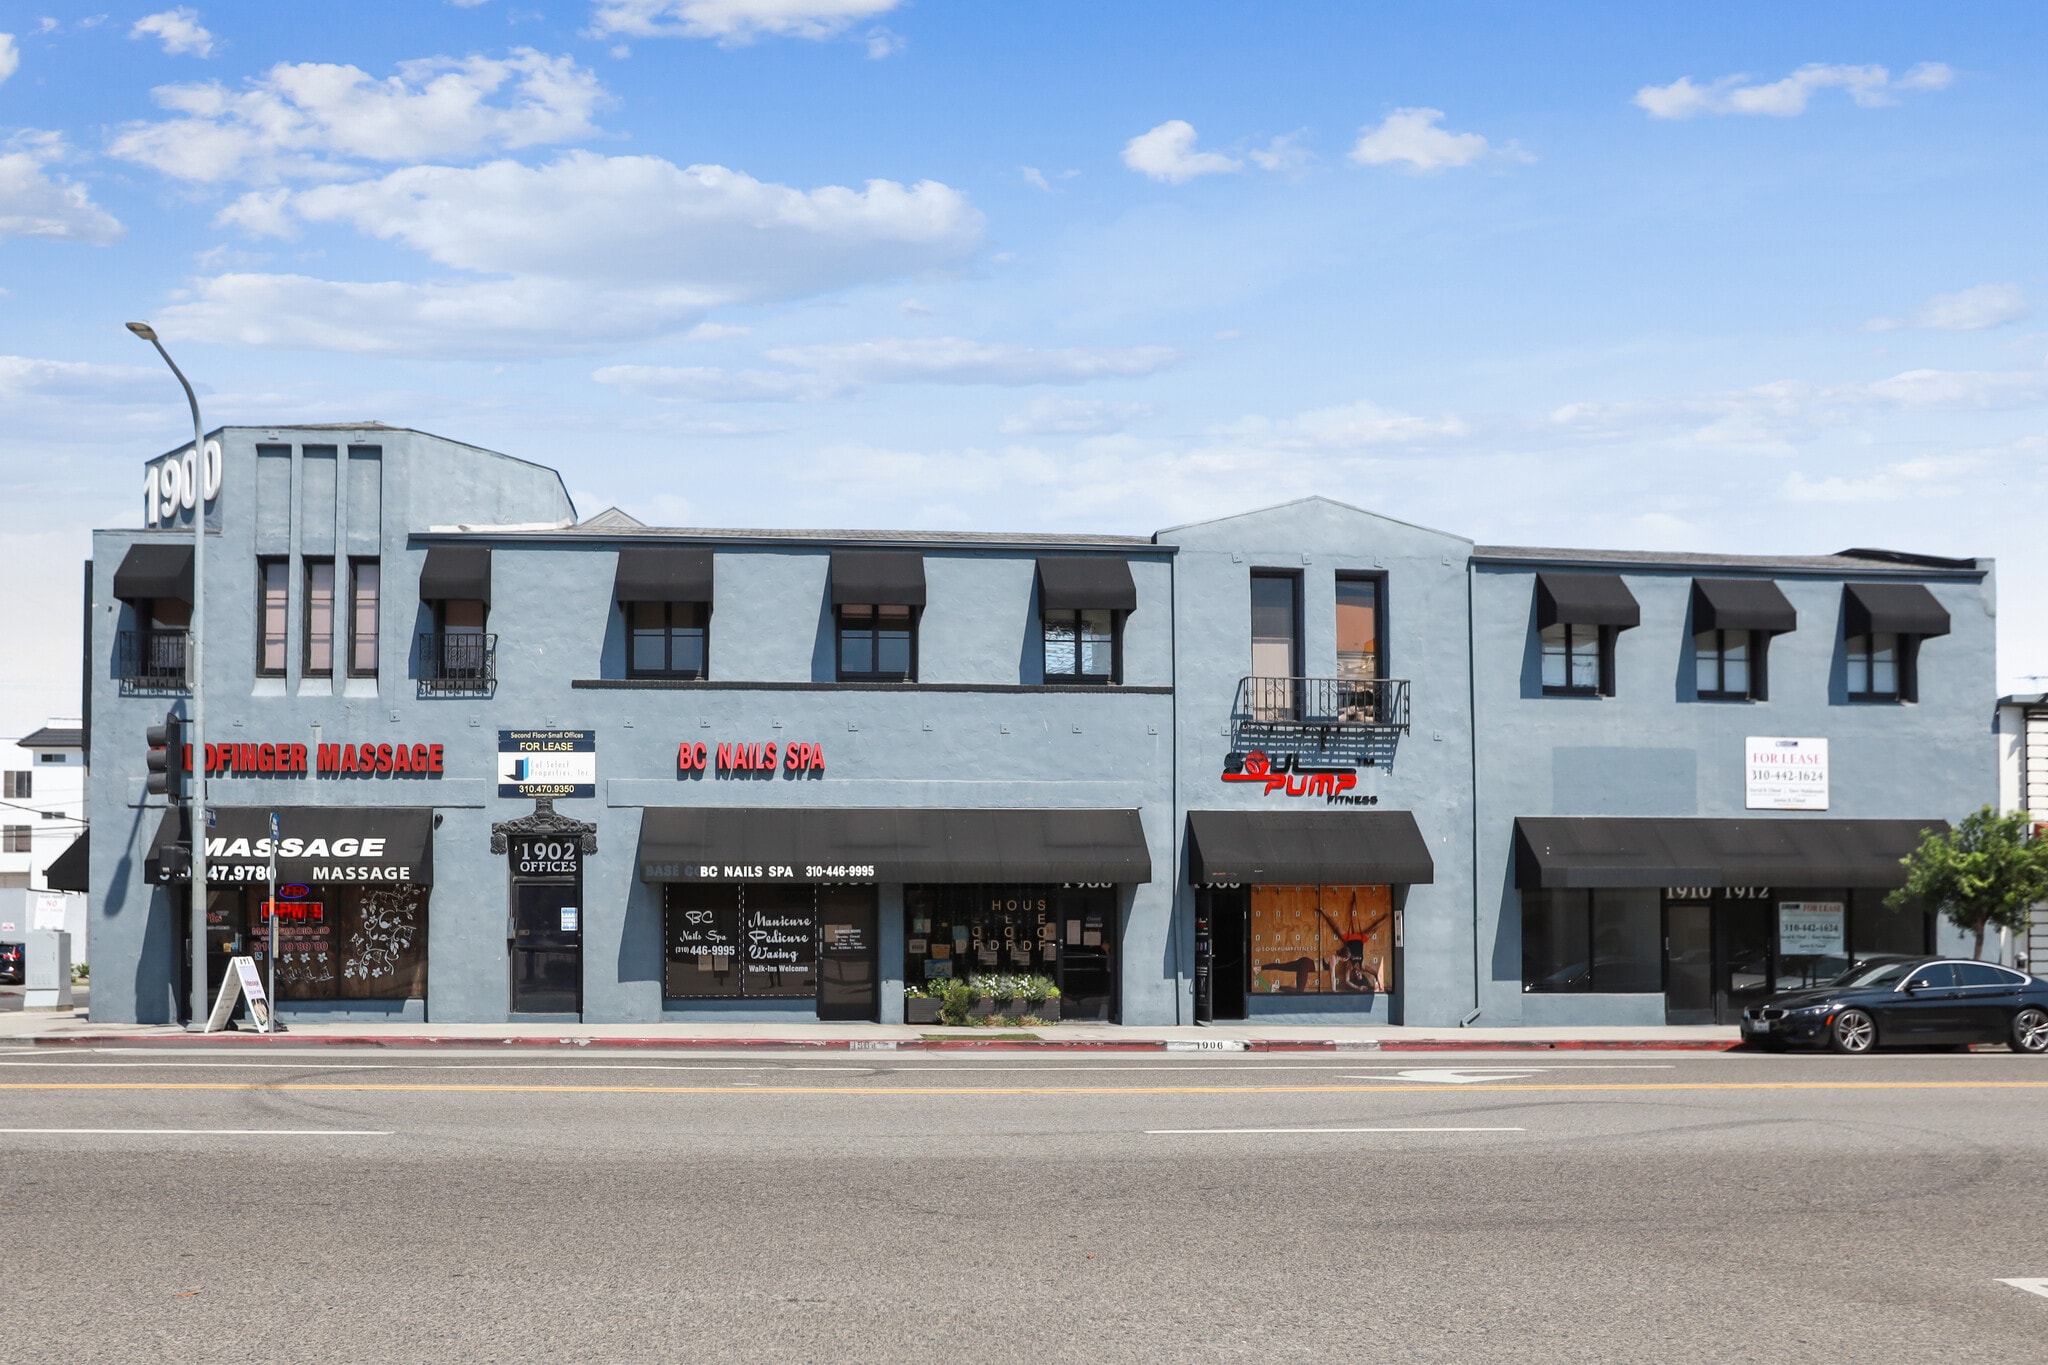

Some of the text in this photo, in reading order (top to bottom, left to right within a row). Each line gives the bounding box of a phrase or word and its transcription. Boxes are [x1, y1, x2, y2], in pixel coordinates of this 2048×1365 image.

[144, 440, 221, 524] 1900
[520, 742, 574, 751] FOR LEASE
[317, 743, 444, 772] MASSAGE
[679, 742, 825, 770] BC NAILS SPA
[1753, 753, 1819, 764] FOR LEASE
[1752, 770, 1823, 781] 310-442-1624
[518, 785, 575, 793] 310.470.9350
[1221, 773, 1358, 796] PUMP
[1326, 795, 1379, 806] FITNESS
[205, 837, 386, 858] MASSAGE
[521, 843, 575, 860] 1902
[312, 866, 410, 880] MASSAGE
[520, 861, 577, 872] OFFICES
[700, 865, 875, 878] BC NAILS SPA 310-446-9995
[1803, 904, 1818, 912] FOR
[1818, 904, 1842, 912] LEASE
[685, 910, 714, 925] BC
[748, 911, 812, 928] Manicure
[1784, 924, 1839, 932] 310-442-1624
[679, 930, 728, 943] Nails Spa
[748, 928, 809, 945] Pedicure
[675, 945, 736, 956] (310) 446-9995
[748, 945, 799, 962] Waxing
[1196, 1041, 1224, 1050] 1906
